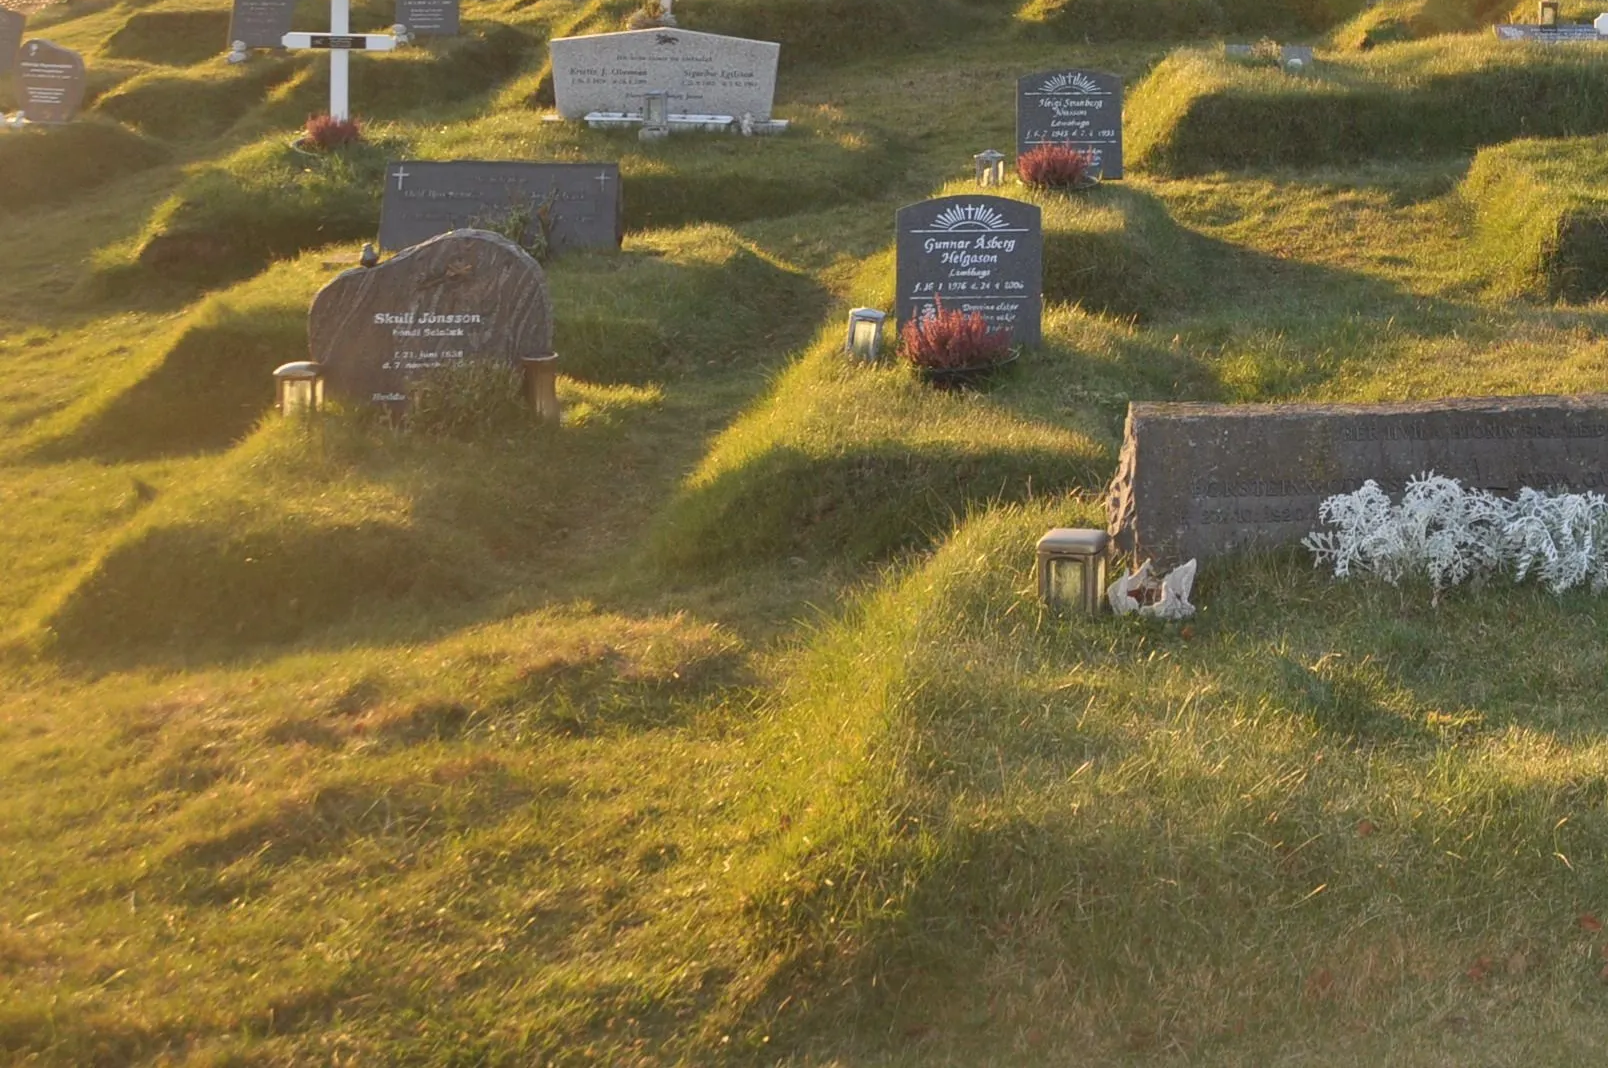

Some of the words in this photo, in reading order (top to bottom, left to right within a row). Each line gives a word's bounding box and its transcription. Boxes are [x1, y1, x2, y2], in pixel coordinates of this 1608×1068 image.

[924, 238, 970, 253] Gunnar
[974, 234, 1016, 252] Ásberg
[940, 250, 998, 266] Helgason
[374, 312, 415, 324] Skúli
[418, 311, 481, 324] Jónsson
